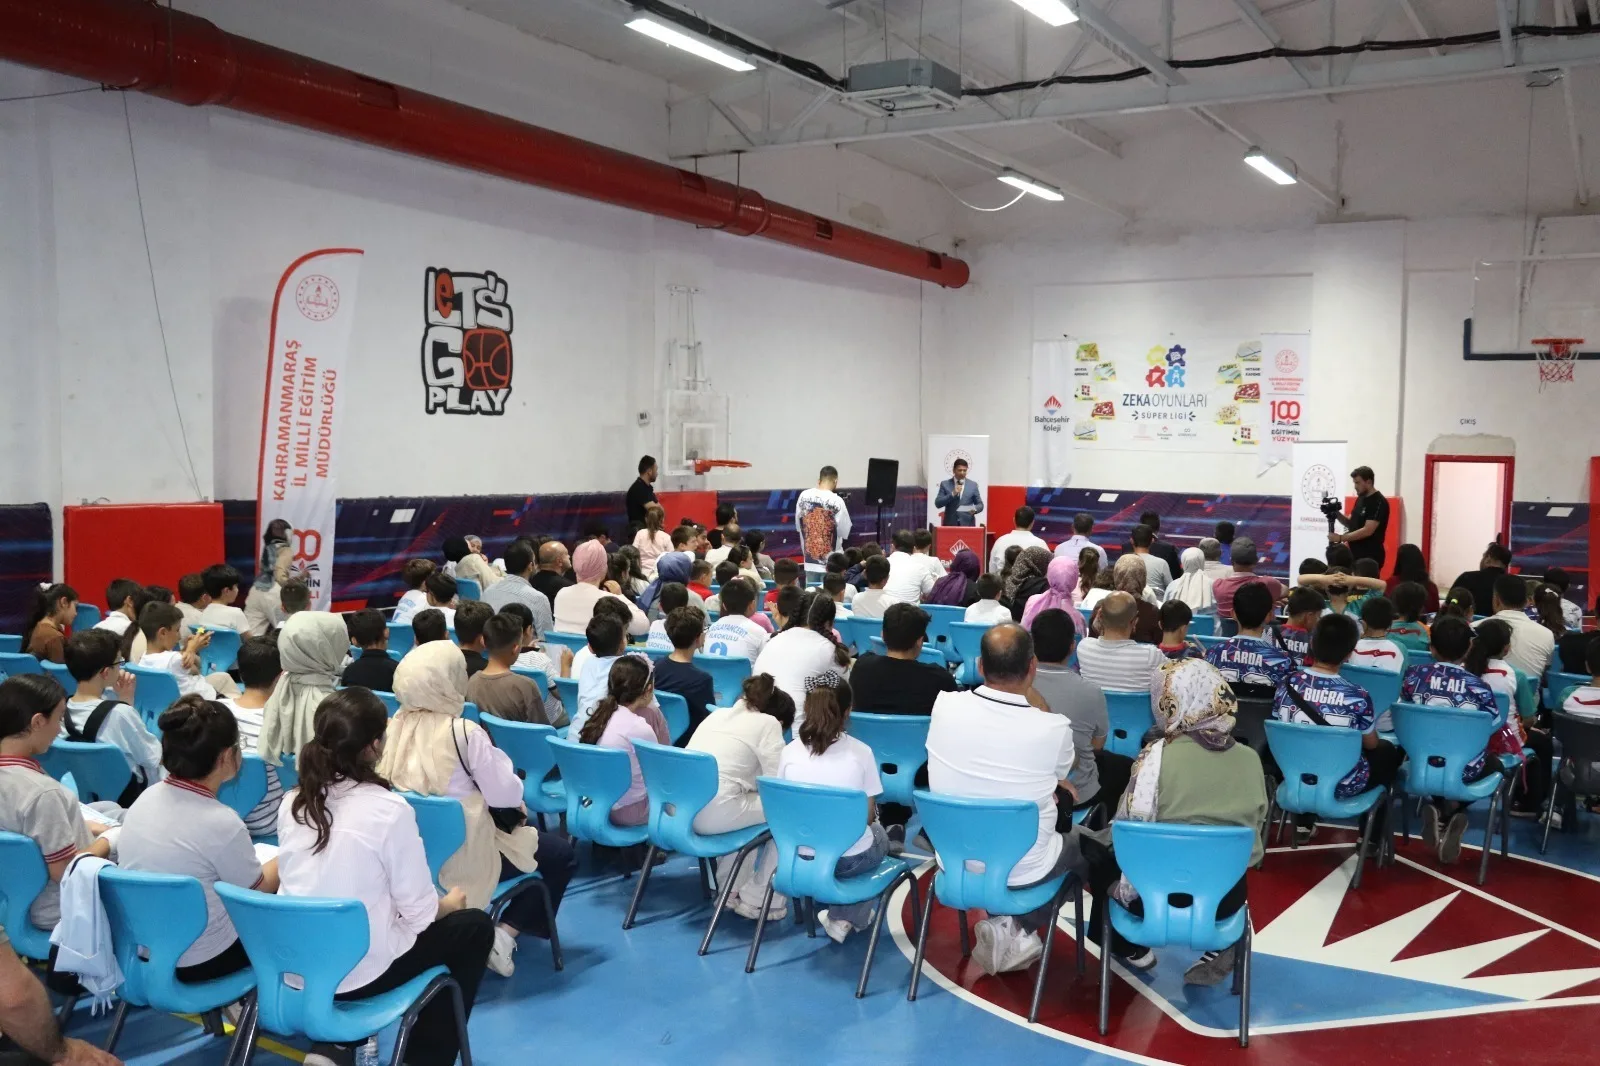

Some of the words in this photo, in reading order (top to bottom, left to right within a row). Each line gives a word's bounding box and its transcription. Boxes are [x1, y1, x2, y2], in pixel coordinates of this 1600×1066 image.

[298, 357, 317, 417] EĞİTİM
[427, 385, 511, 414] PLAY
[1122, 393, 1151, 407] ZEKA
[1152, 393, 1208, 407] OYUNLARI
[273, 339, 302, 501] KAHRAMANMARAŞ
[1141, 411, 1168, 420] SÜPER
[1270, 400, 1301, 424] 100
[315, 369, 337, 478] MÜDÜRLÜĞÜ
[1043, 424, 1061, 433] Koleji
[291, 472, 308, 487] İL
[1221, 649, 1230, 662] A.
[1234, 650, 1263, 667] ARDA
[1430, 676, 1443, 690] M.
[1303, 687, 1345, 706] BUĞRA
